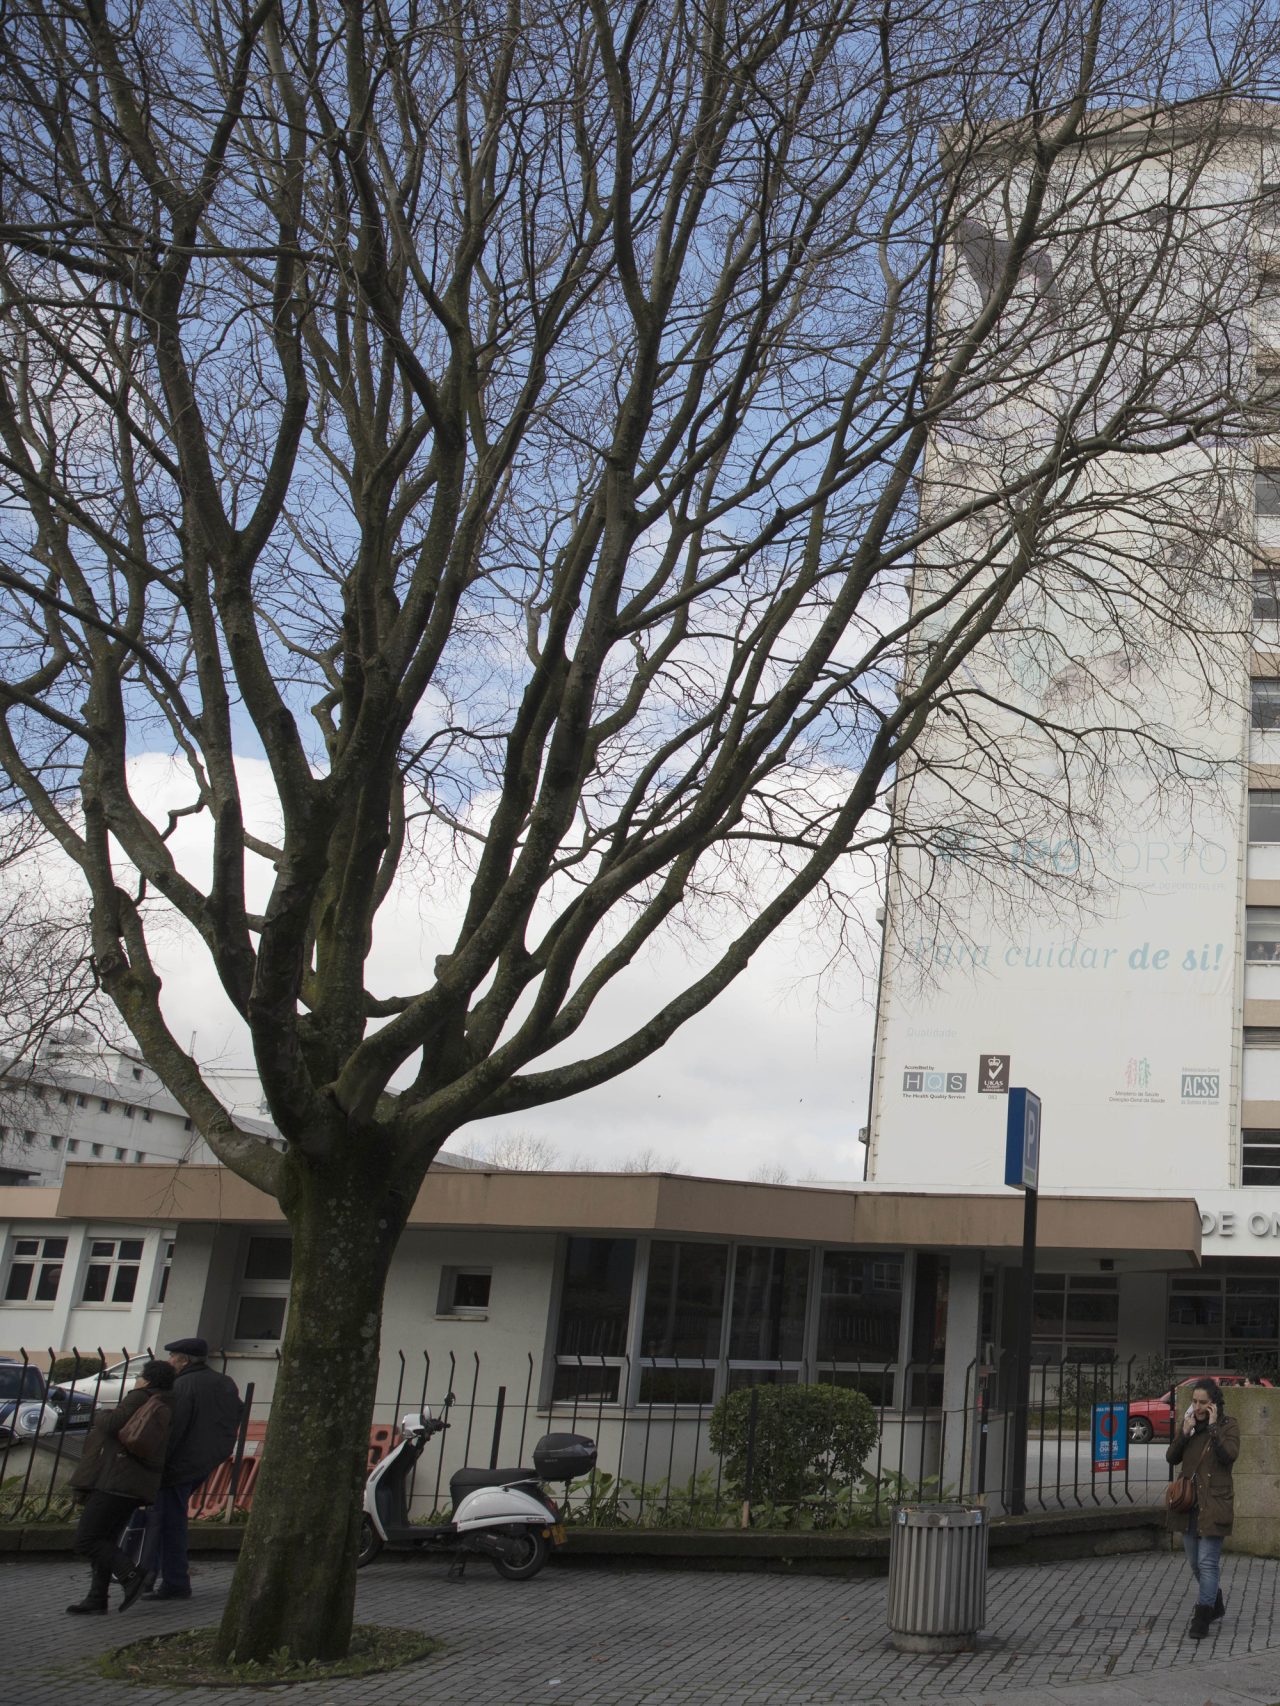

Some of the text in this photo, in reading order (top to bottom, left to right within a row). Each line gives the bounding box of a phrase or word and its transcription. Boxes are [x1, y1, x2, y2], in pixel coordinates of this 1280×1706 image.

[1003, 942, 1118, 969] cuidar
[1128, 943, 1170, 970] de
[1181, 943, 1225, 971] si!
[906, 1027, 957, 1039] Qualidade
[906, 1074, 963, 1090] HQS
[1183, 1076, 1218, 1096] ACSS
[1027, 1110, 1035, 1159] P
[1201, 1211, 1236, 1237] DE
